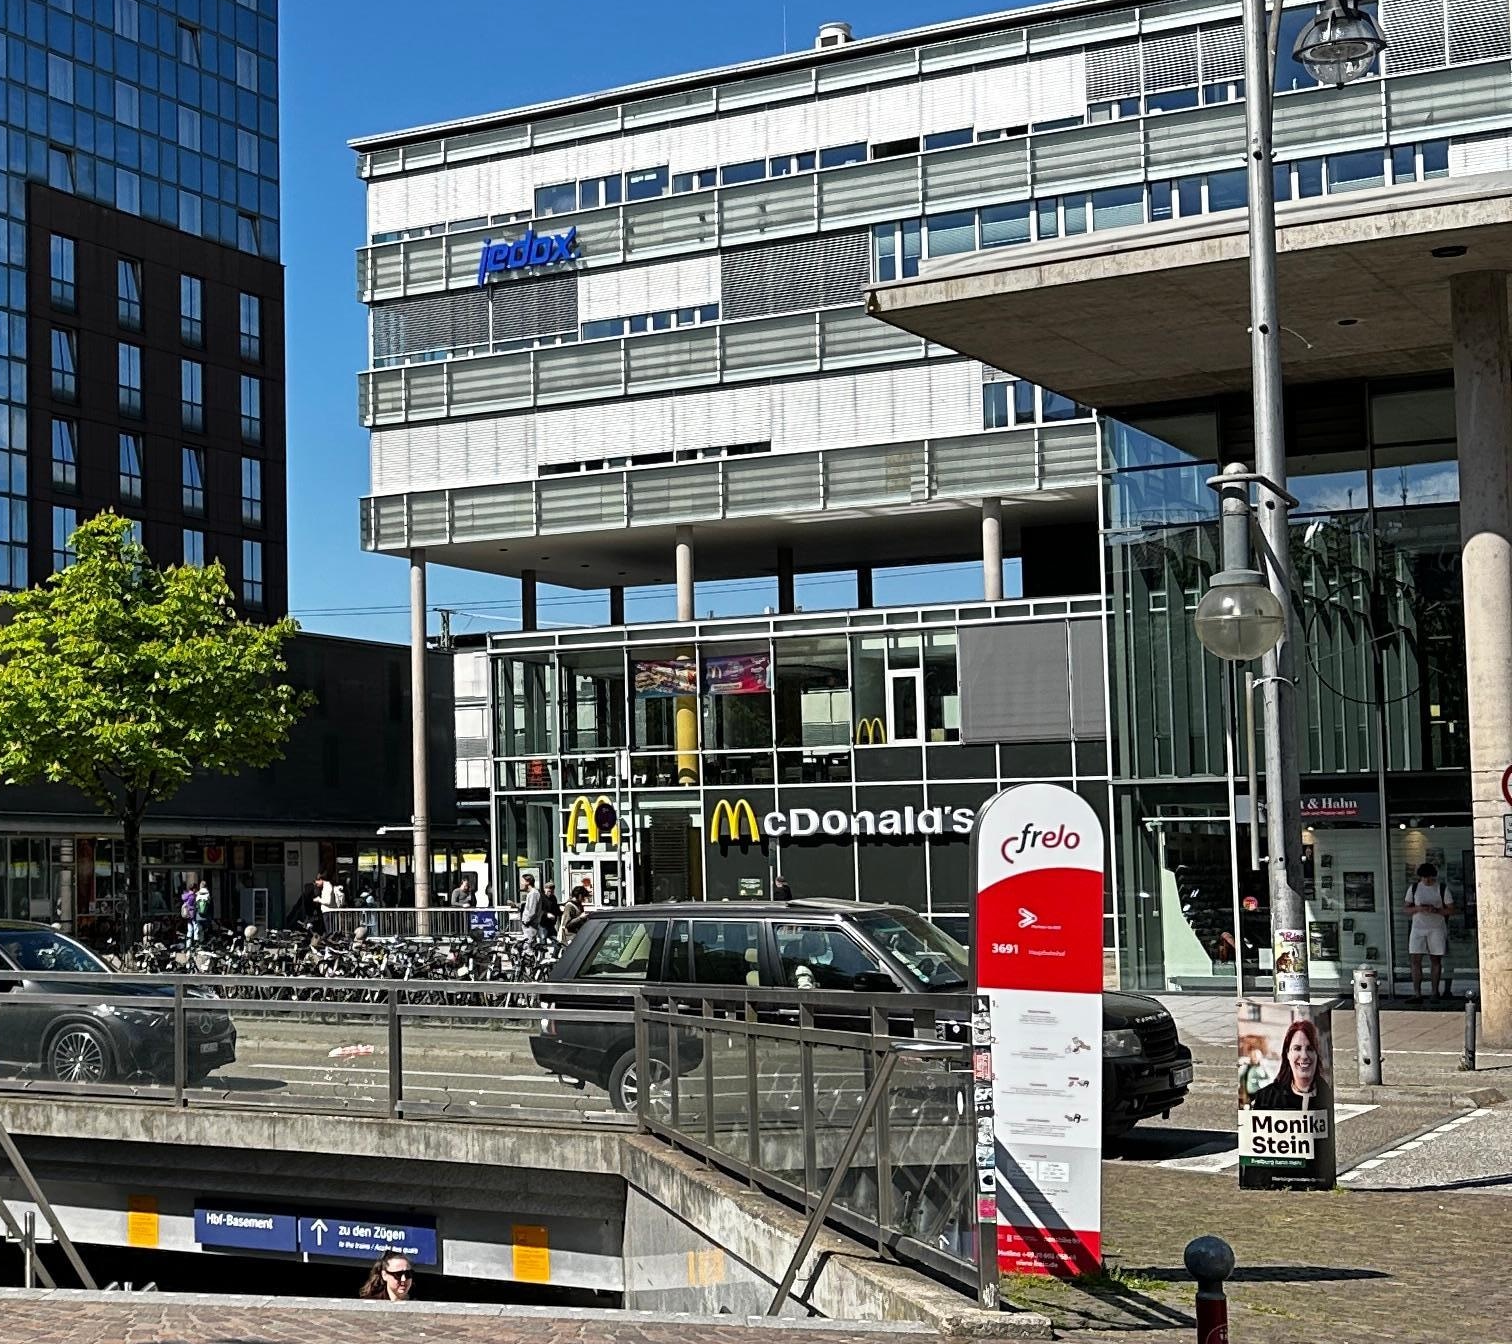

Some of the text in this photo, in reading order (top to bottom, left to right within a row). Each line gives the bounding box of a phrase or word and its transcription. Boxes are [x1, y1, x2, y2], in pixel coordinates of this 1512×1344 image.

[1307, 797, 1319, 810] &
[1321, 797, 1358, 809] Hahn
[1015, 822, 1080, 854] frelo
[991, 942, 1019, 955] 3691
[1251, 1114, 1326, 1134] Monika
[1251, 1135, 1310, 1154] Stein
[206, 1212, 273, 1230] Hbf-Basement
[338, 1225, 406, 1242] zu den Zügen
